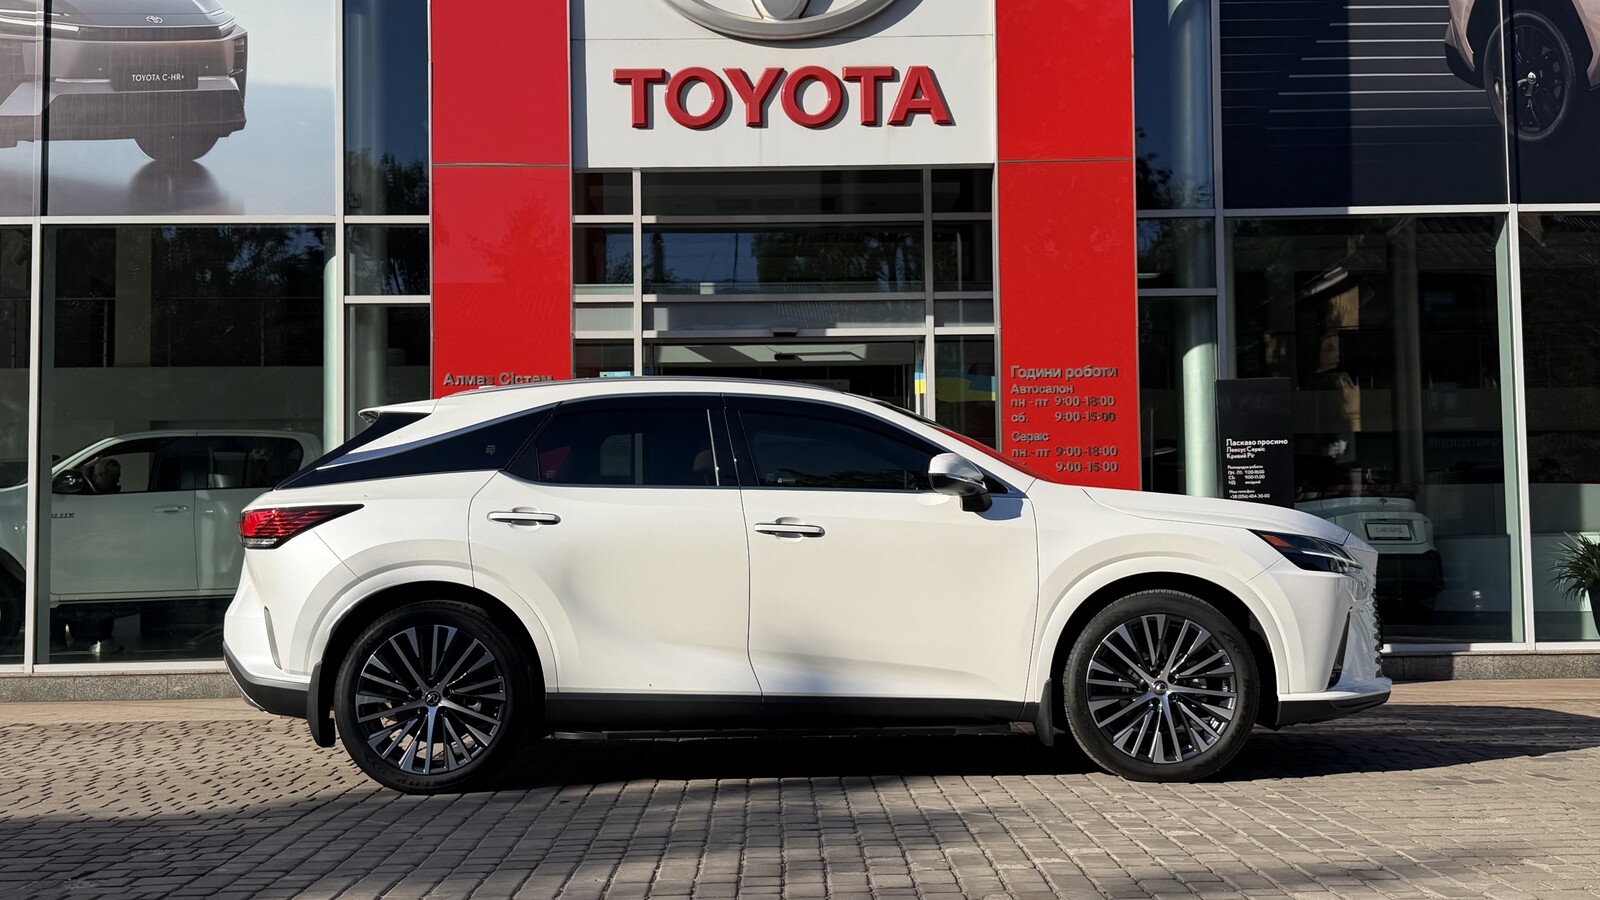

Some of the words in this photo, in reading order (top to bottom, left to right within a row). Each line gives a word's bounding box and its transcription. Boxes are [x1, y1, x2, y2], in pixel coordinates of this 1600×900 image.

[131, 74, 160, 82] TOYOTA
[162, 73, 185, 81] C-HR+
[613, 65, 953, 128] TOYOTA
[443, 372, 496, 386] Алмаз
[1010, 365, 1062, 380] Години
[1065, 365, 1118, 381] роботи
[1010, 384, 1074, 394] Автосалон
[1011, 412, 1029, 423] сб.
[1011, 431, 1050, 444] Сервіс
